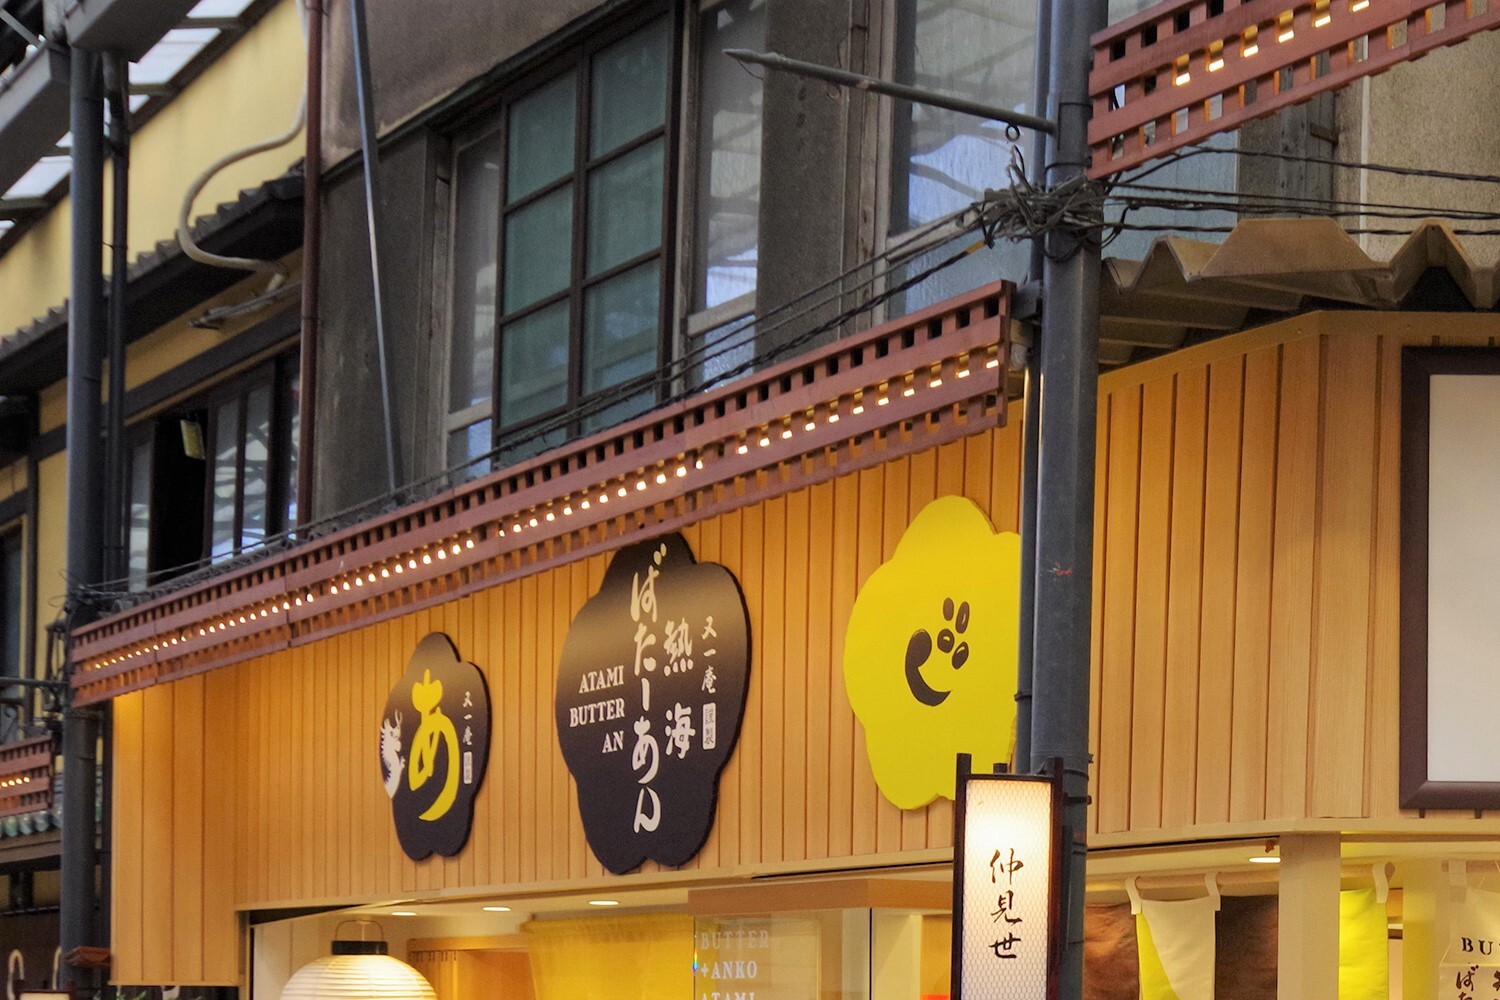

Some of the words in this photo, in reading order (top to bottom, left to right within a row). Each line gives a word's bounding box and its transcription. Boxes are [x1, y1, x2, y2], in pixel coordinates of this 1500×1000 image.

[578, 664, 625, 694] ATAMI
[701, 615, 718, 694] 又一庵
[569, 697, 626, 728] BUTTER
[630, 542, 667, 834] ばたーあん
[663, 616, 696, 760] 熱海
[602, 730, 625, 754] AN
[988, 847, 1024, 959] 仲見世
[700, 929, 770, 949] BUTTER
